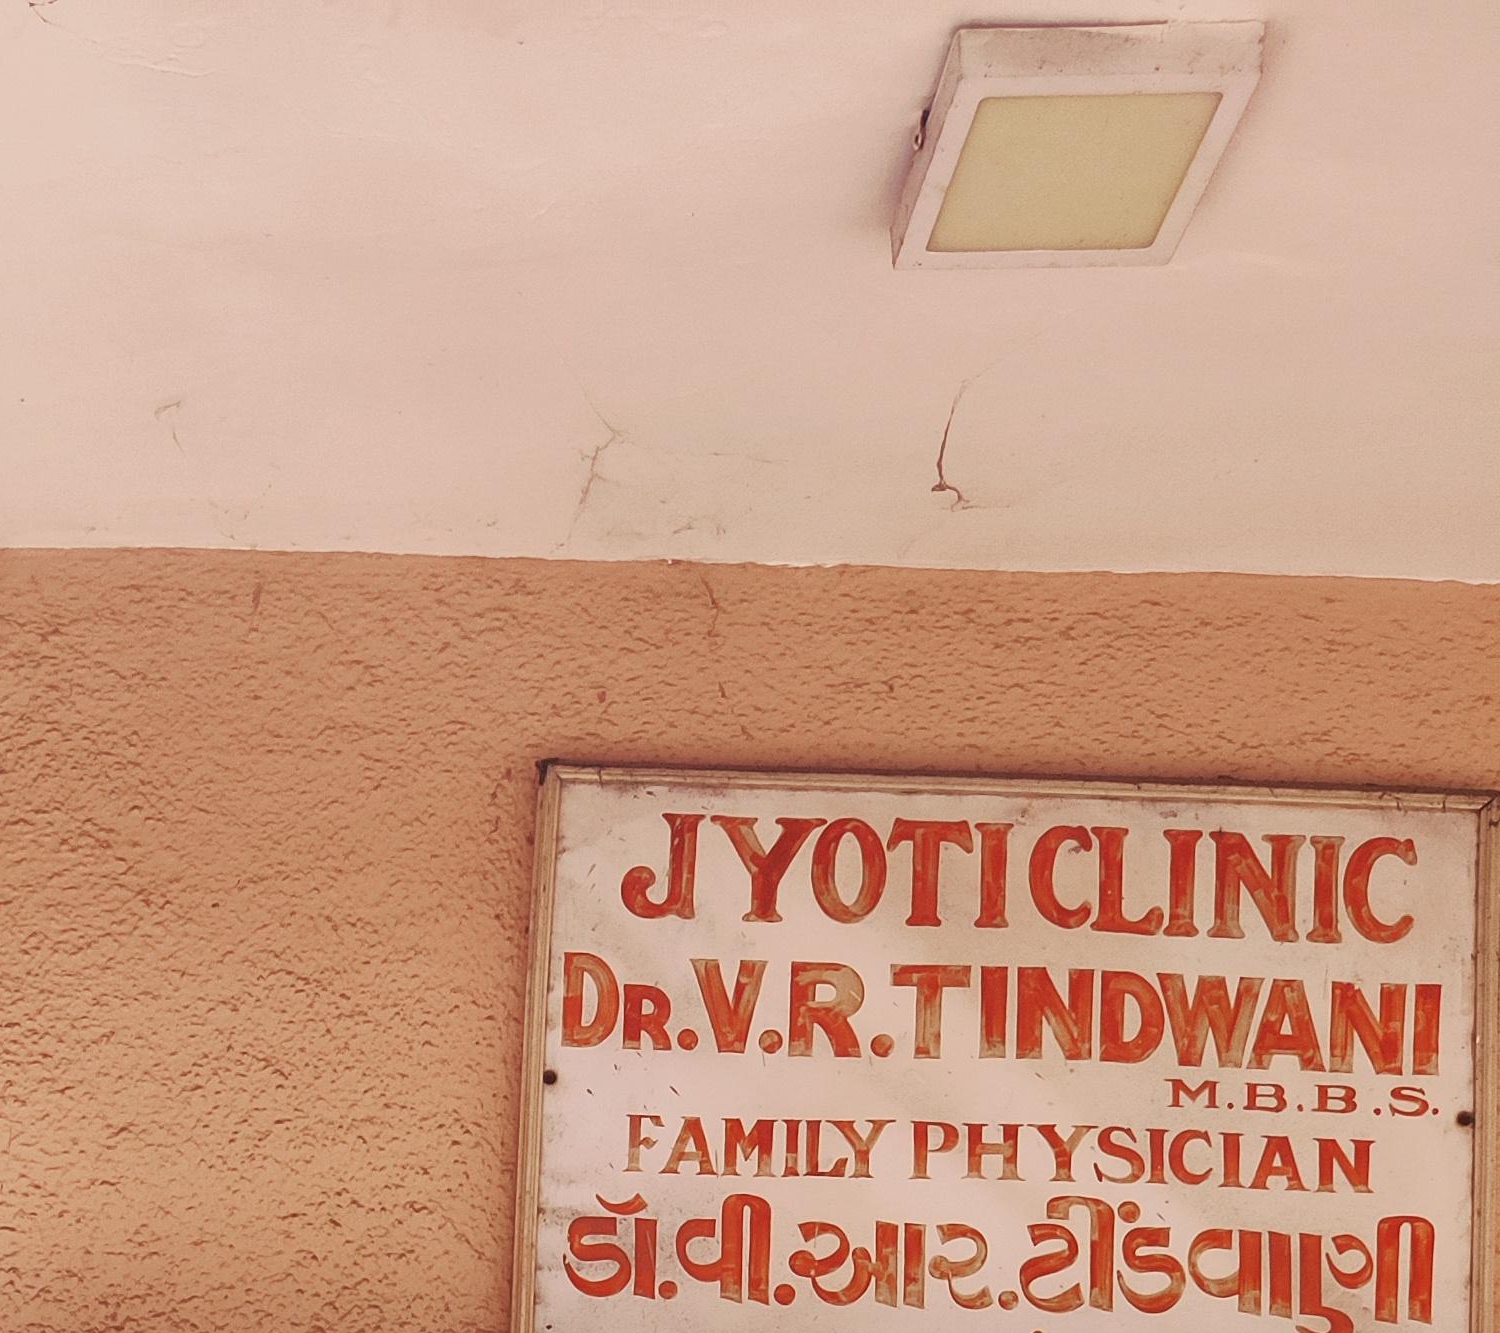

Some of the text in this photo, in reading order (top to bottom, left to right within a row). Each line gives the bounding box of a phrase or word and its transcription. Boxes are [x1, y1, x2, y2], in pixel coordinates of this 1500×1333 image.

[620, 811, 1418, 945] JYOTI CLINIC
[623, 1112, 1376, 1195] FAMILY PHYSICIAN
